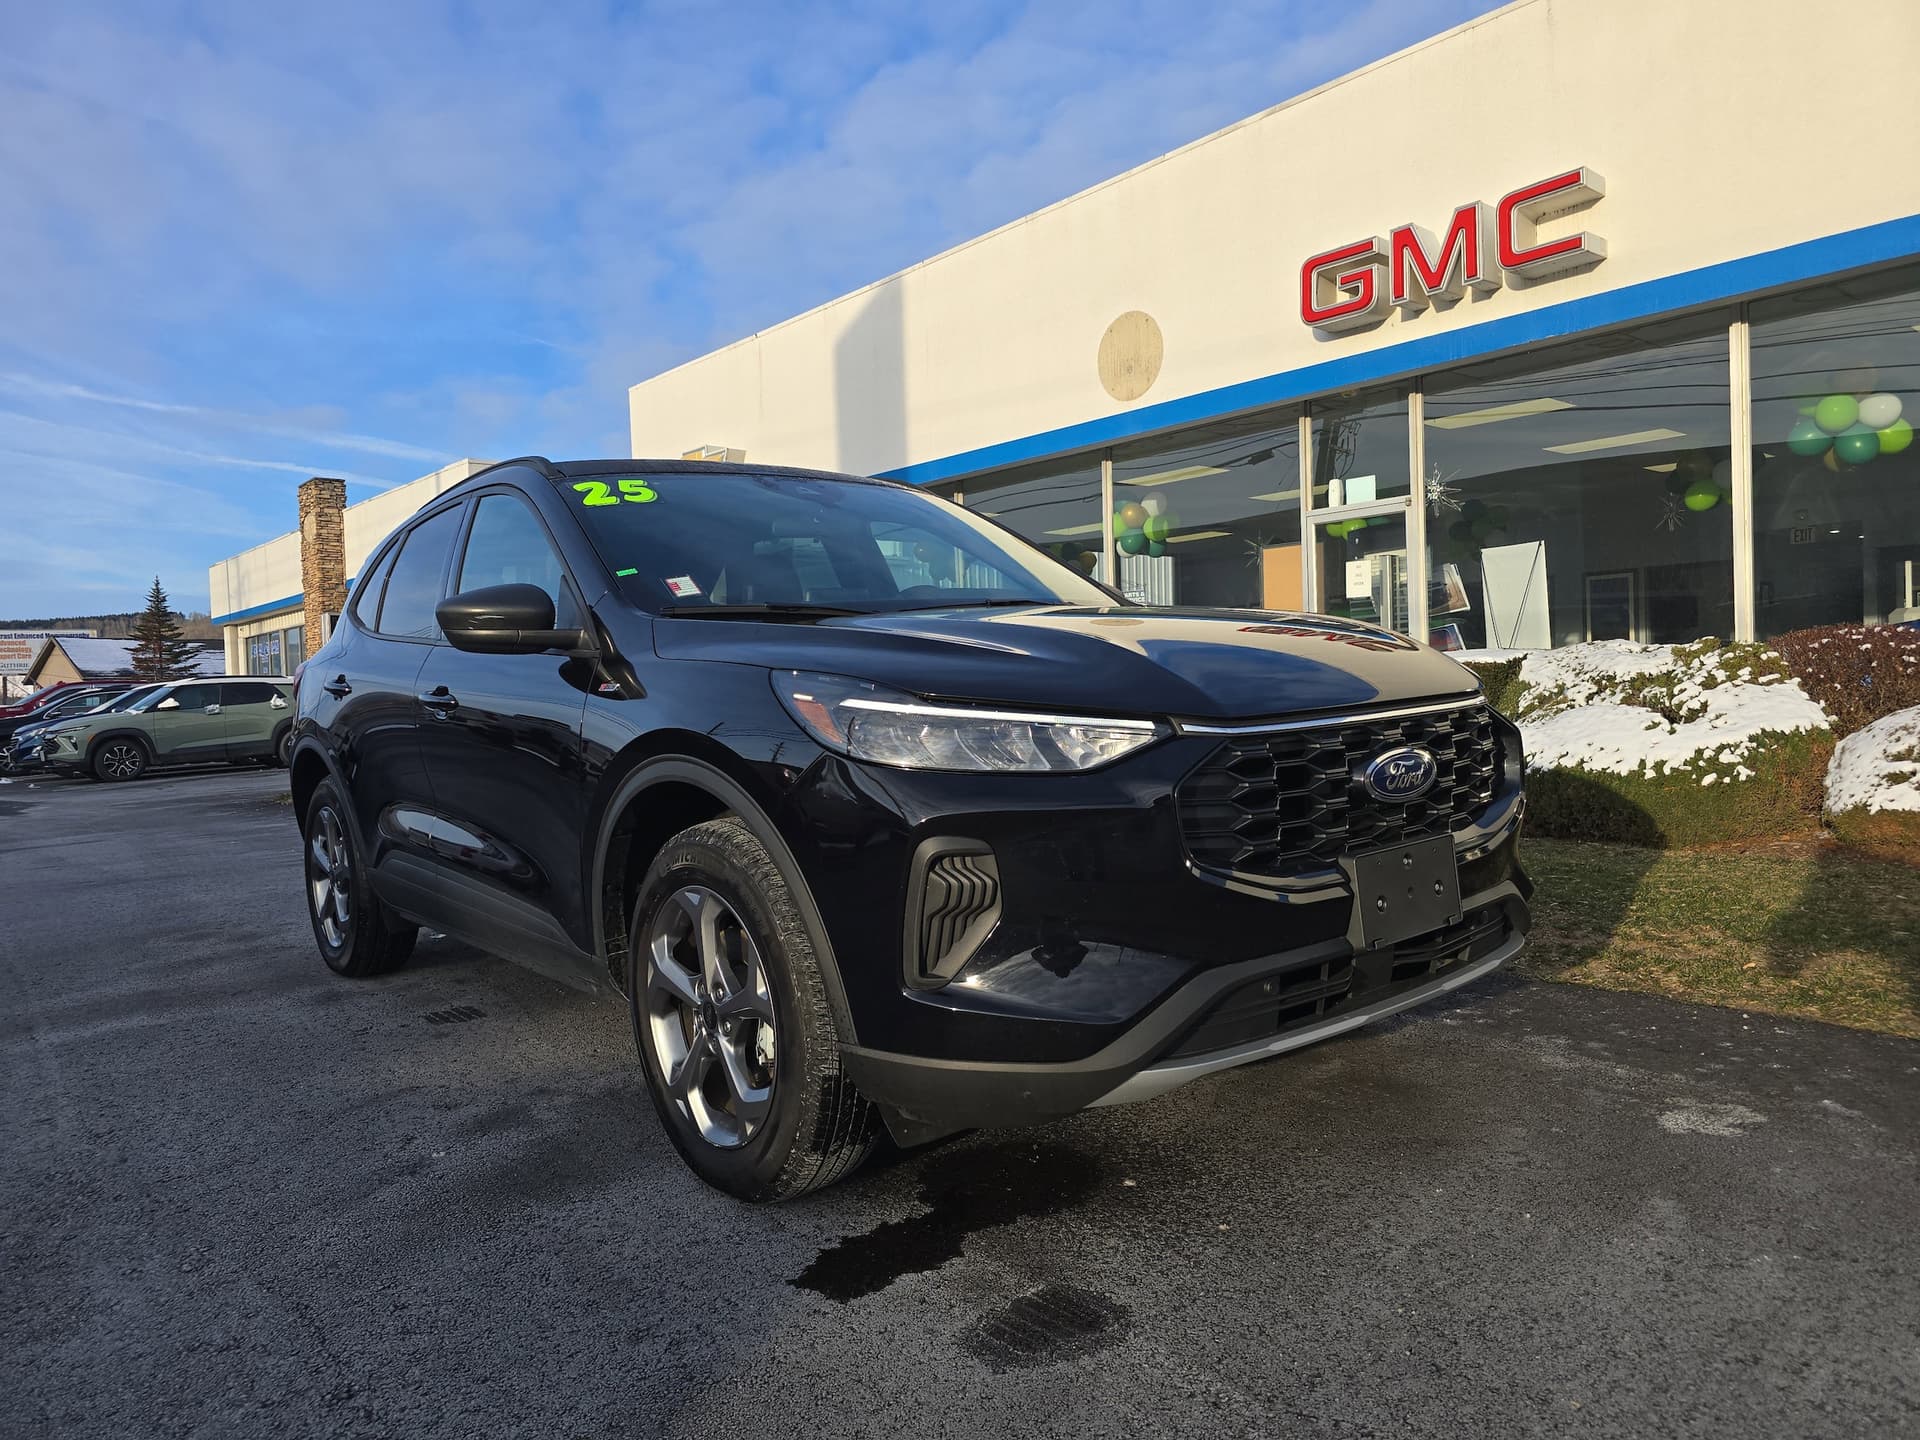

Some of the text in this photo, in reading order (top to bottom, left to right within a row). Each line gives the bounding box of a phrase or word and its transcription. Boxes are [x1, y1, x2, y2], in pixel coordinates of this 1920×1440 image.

[1300, 166, 1602, 329] GMC
[572, 479, 658, 506] 25
[1794, 529, 1812, 542] EXIT
[1385, 760, 1429, 791] Ford
